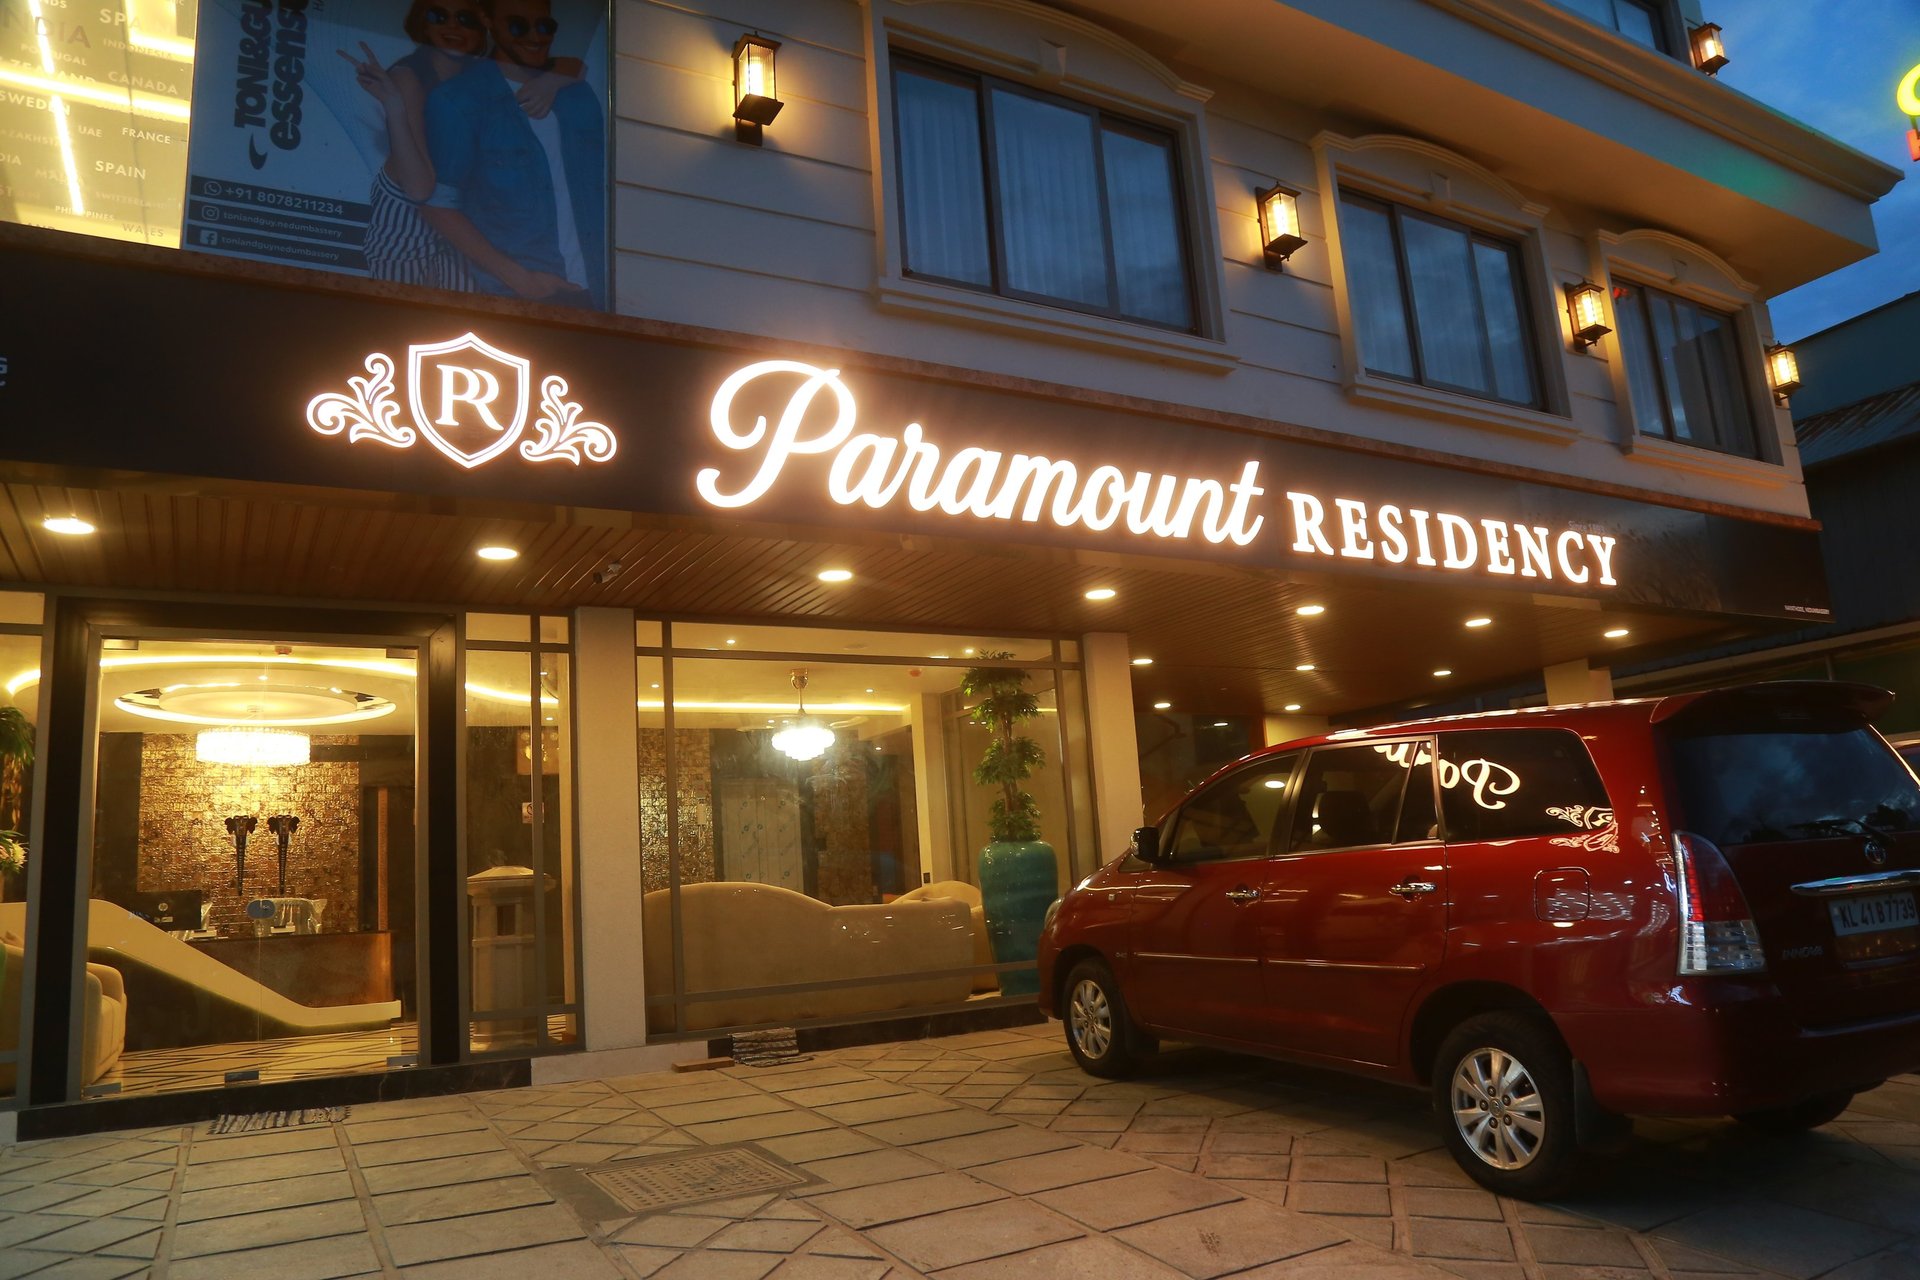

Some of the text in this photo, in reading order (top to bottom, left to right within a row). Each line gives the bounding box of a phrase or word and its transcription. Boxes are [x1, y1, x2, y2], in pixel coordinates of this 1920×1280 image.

[108, 70, 179, 96] CANADA
[77, 125, 103, 138] UAE
[121, 127, 172, 145] FRANCE
[95, 160, 147, 180] SPAIN
[225, 187, 344, 216] +91 8078211234
[696, 359, 1618, 587] Paramount RESIDENCY
